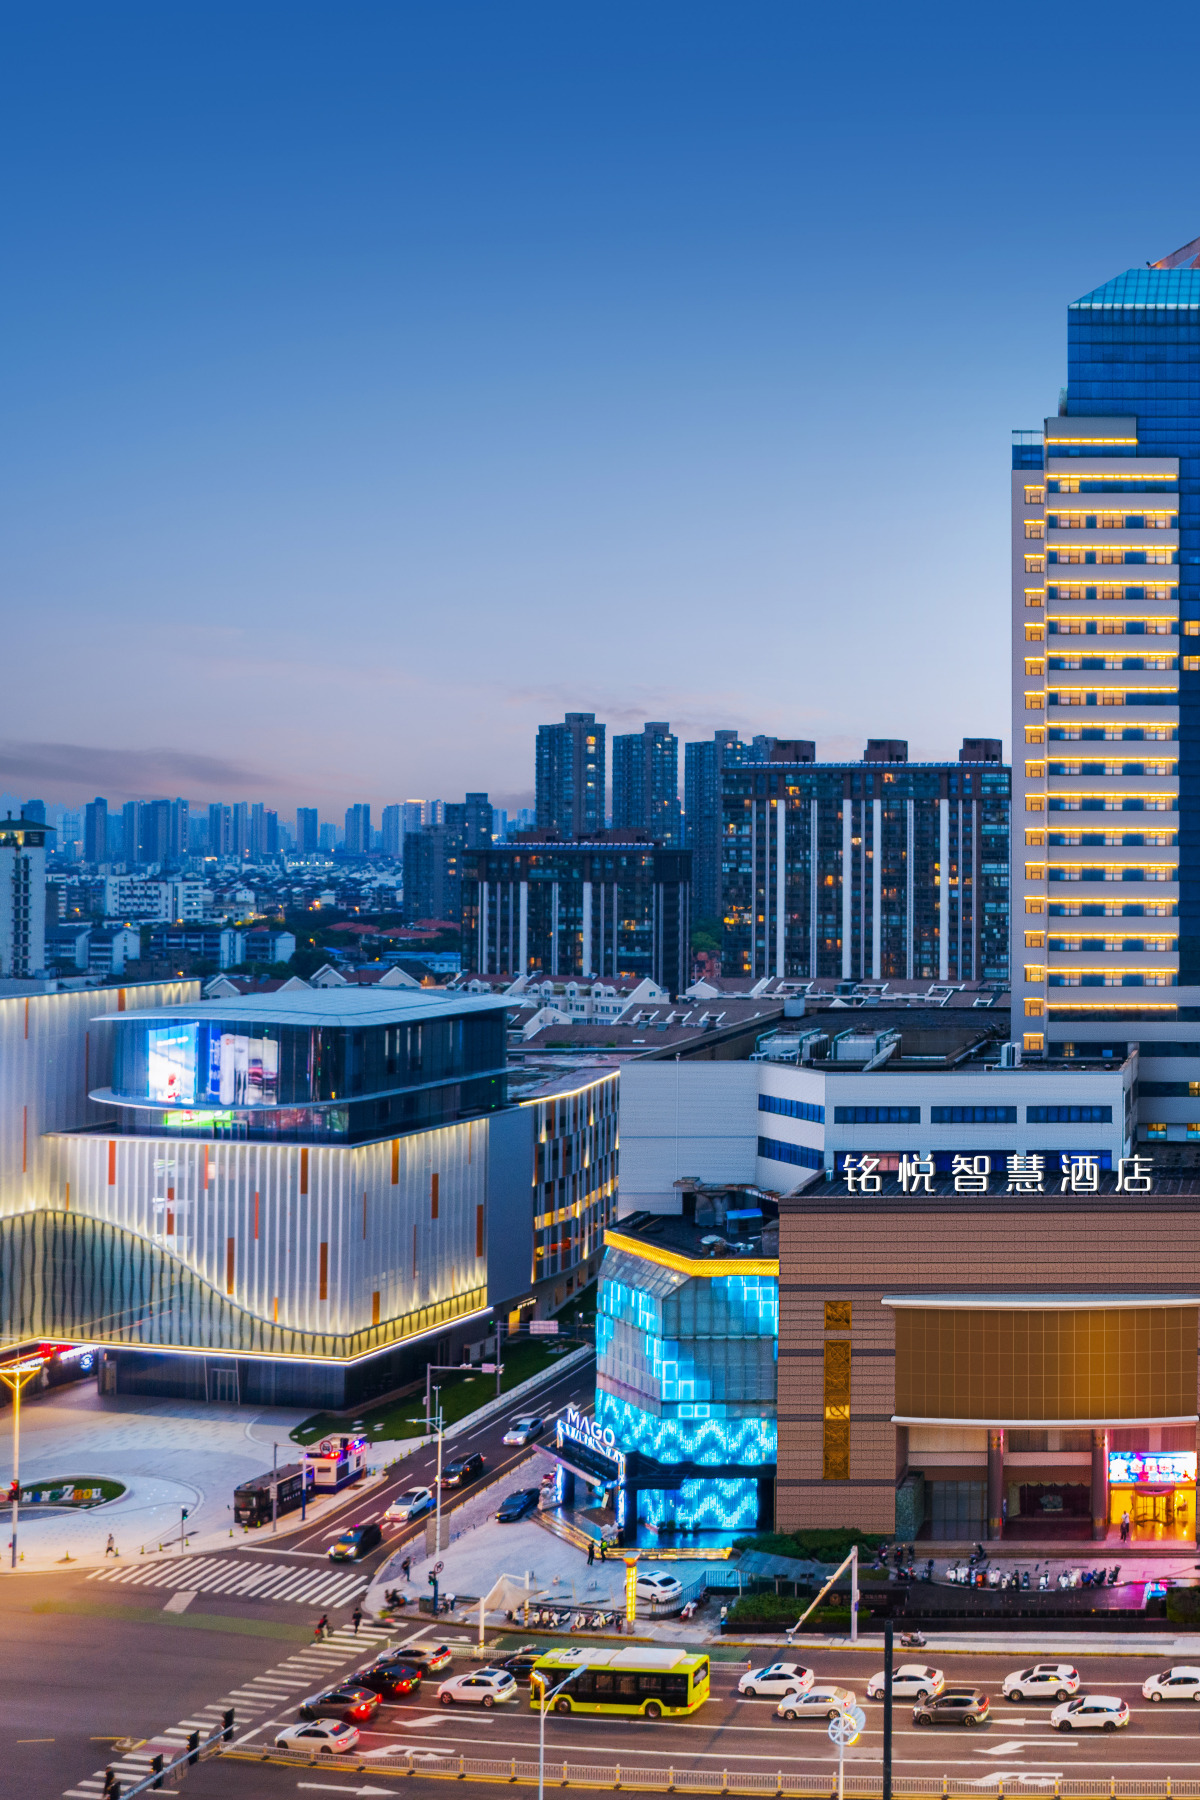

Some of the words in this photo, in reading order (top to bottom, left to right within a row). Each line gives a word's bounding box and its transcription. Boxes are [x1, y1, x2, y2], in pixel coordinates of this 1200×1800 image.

[842, 1153, 1155, 1193] 铭悦智慧酒店
[567, 1407, 616, 1447] MAGO
